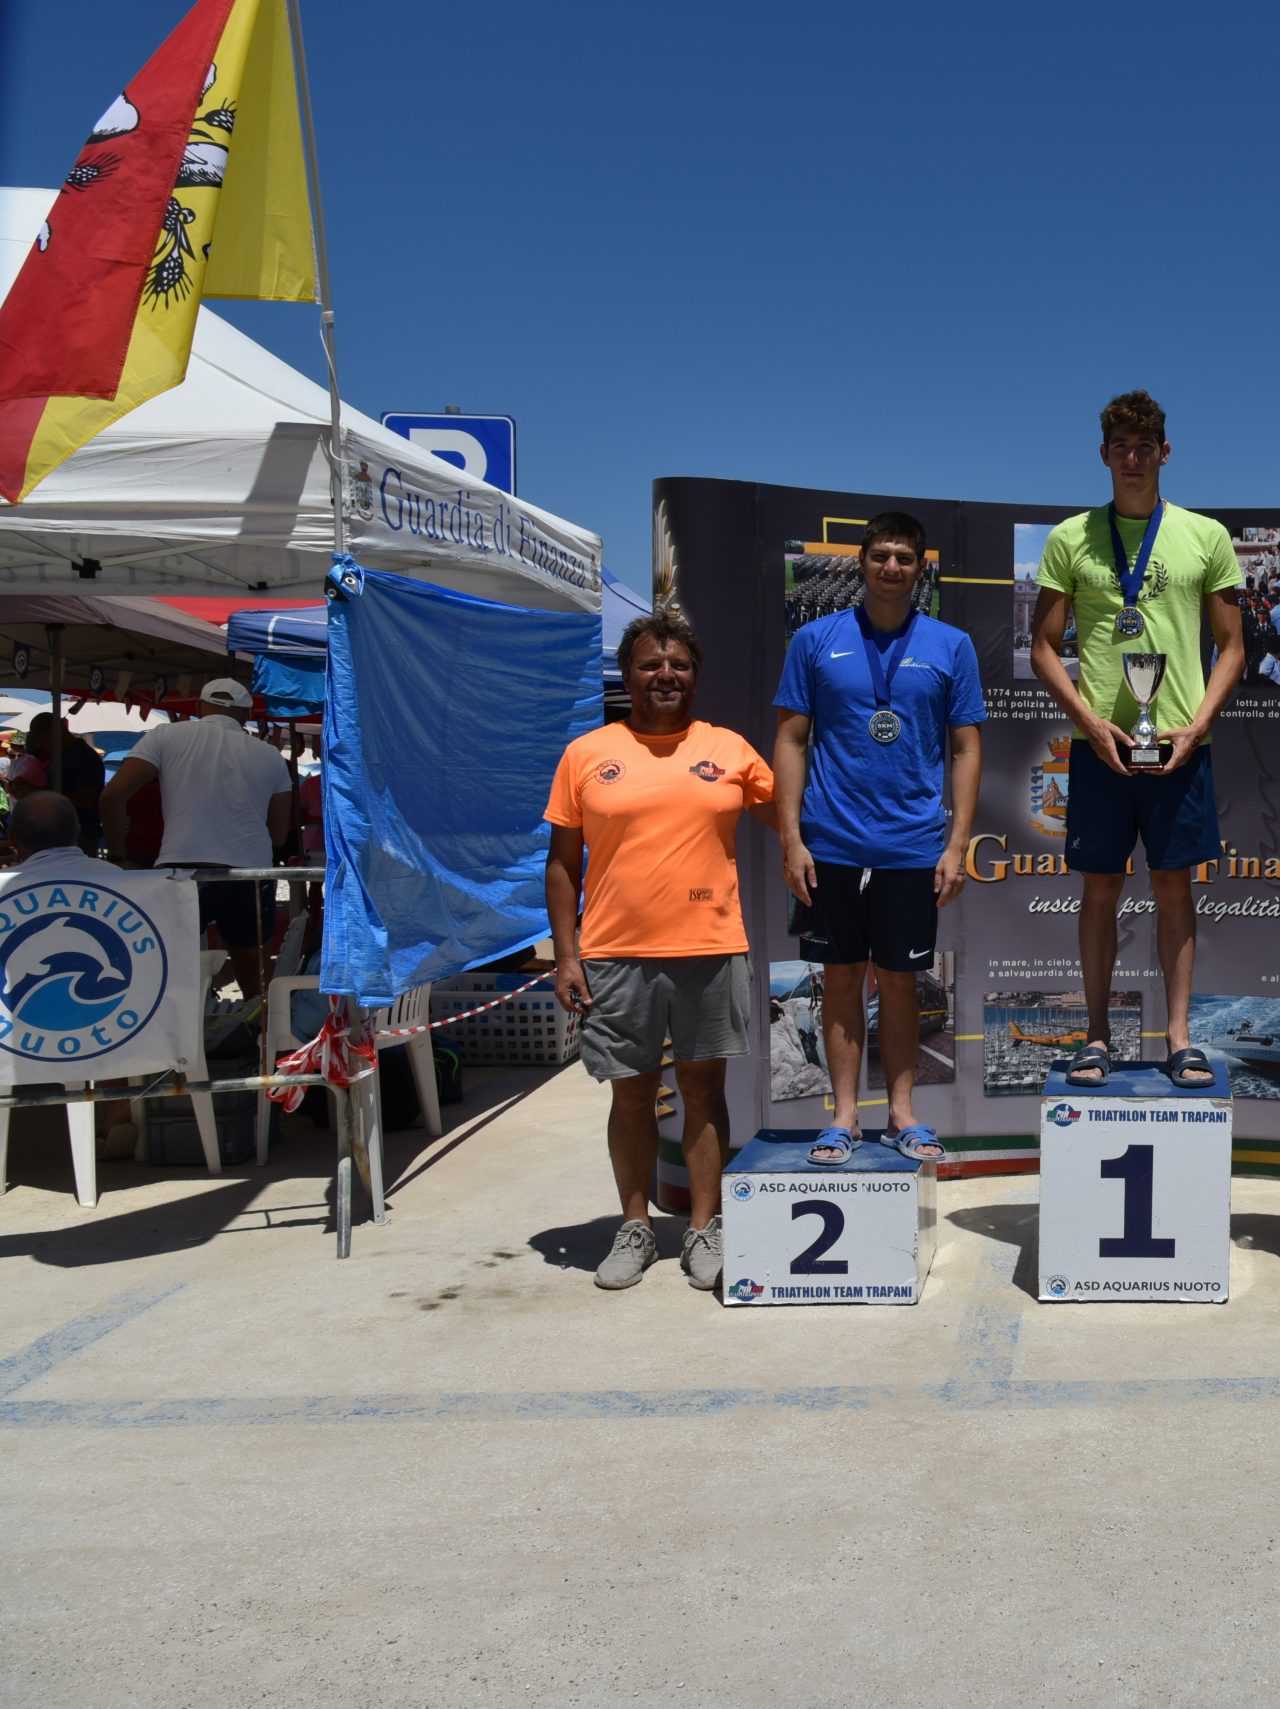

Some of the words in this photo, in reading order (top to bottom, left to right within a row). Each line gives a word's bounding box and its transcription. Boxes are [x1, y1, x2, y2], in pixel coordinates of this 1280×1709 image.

[380, 467, 489, 550] Guardia
[493, 504, 512, 557] di
[519, 515, 586, 590] Finanza
[987, 688, 1010, 696] 1774
[997, 699, 1007, 708] di
[1010, 699, 1045, 710] polizia
[1236, 699, 1258, 707] lotta
[1012, 711, 1037, 720] degli
[1041, 711, 1070, 720] Italia
[1220, 710, 1265, 718] controllo
[1028, 896, 1082, 913] insie
[1117, 896, 1156, 919] per
[0, 887, 155, 954] QUARIUS
[989, 959, 998, 967] in
[1002, 959, 1030, 968] mare,
[1034, 959, 1043, 967] in
[1047, 958, 1072, 967] cielo
[998, 969, 1063, 978] salvaguardia
[1143, 969, 1158, 977] del
[1088, 1109, 1146, 1122] TRIATHLON
[1150, 1110, 1178, 1122] TEAM
[1181, 1111, 1227, 1123] TRAPANI
[759, 1182, 786, 1193] ASD
[788, 1182, 858, 1194] AQUARIUS
[862, 1182, 911, 1193] NUOTO
[1099, 1144, 1175, 1258] 1
[789, 1199, 848, 1275] 2
[770, 1286, 830, 1298] TRIATHLON
[833, 1286, 863, 1298] TEAM
[866, 1286, 912, 1298] TRAPANI
[1074, 1281, 1100, 1291] ASD
[1103, 1281, 1170, 1292] AQUARIUS
[1173, 1281, 1221, 1292] NUOTO
